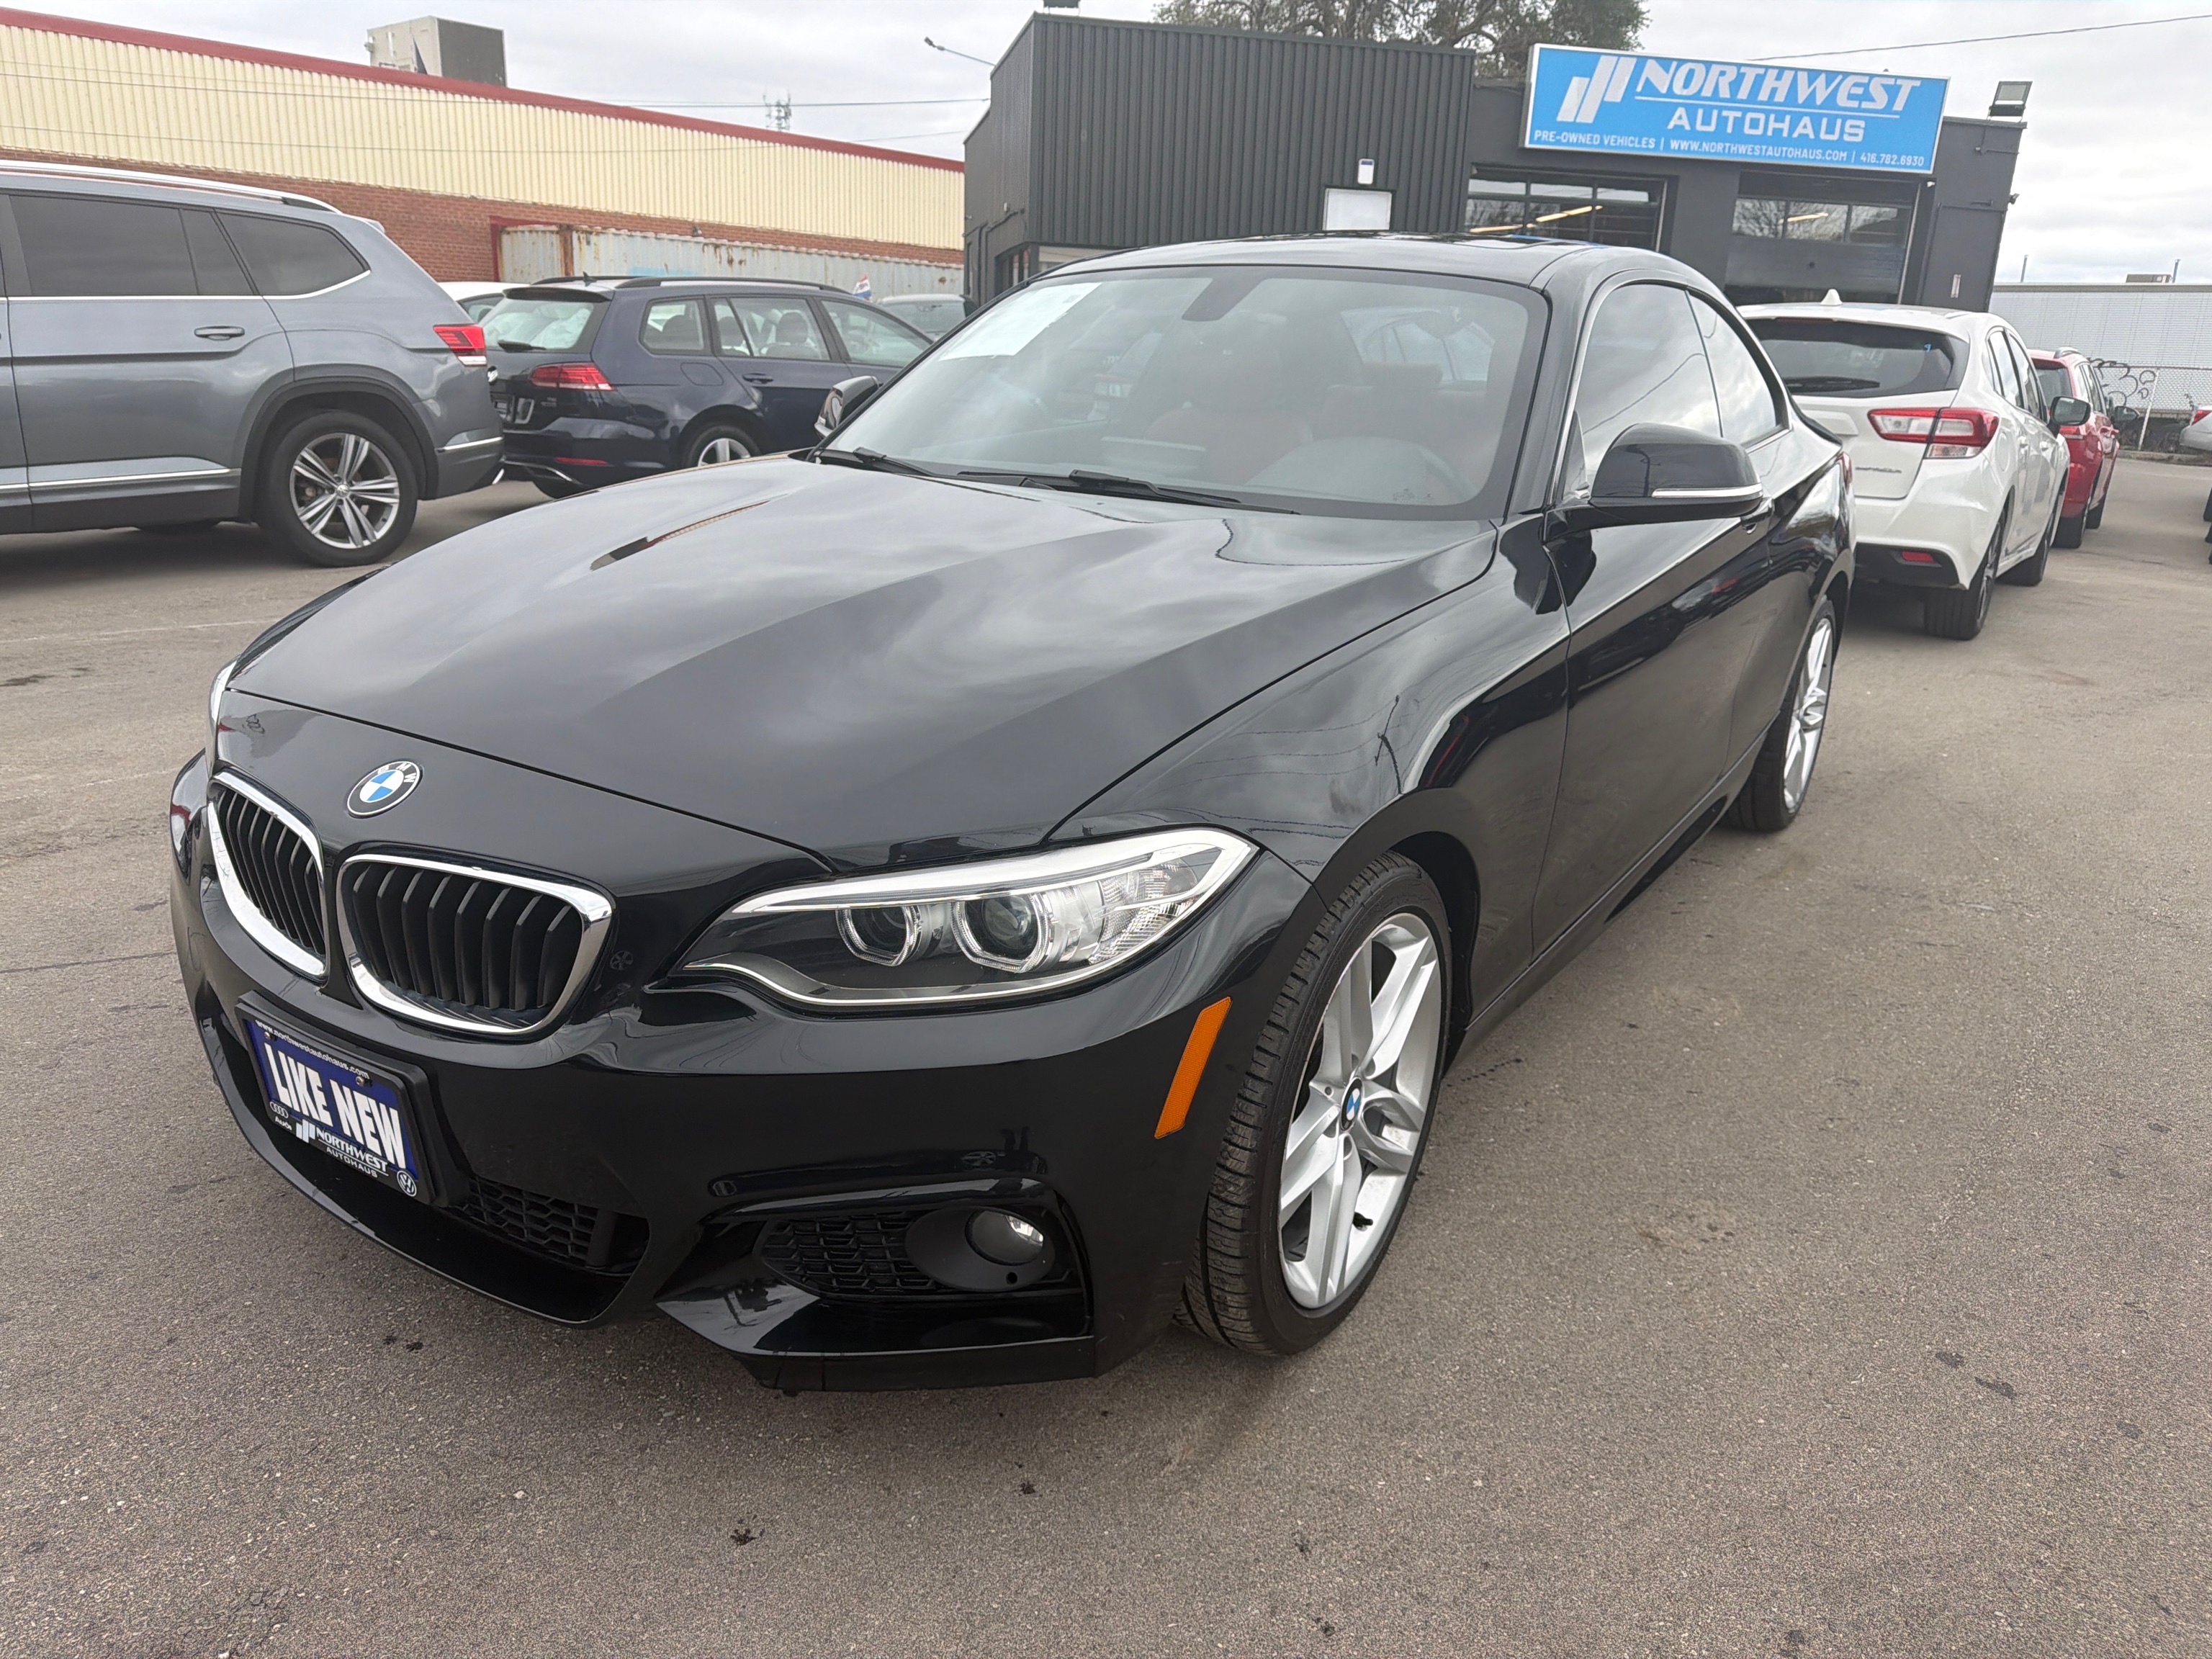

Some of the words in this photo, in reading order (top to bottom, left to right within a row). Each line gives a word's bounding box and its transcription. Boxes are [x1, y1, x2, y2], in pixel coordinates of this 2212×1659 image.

[1635, 58, 1922, 112] NORTHWEST
[1667, 107, 1866, 143] AUTOHAUS
[1534, 129, 1601, 145] PRE-OWNED
[1603, 135, 1656, 149] VEHICLES
[1670, 138, 1848, 161] WWW.NORTHWESTAUTOHAUS.COM
[1860, 153, 1925, 167] 416.782.6930
[377, 762, 417, 783] BMW
[264, 1042, 334, 1128] LIKE
[329, 1078, 406, 1169] NEW
[274, 1115, 292, 1131] Audi
[315, 1126, 389, 1173] NORTHWEST
[326, 1146, 379, 1179] AUTOHAUS
